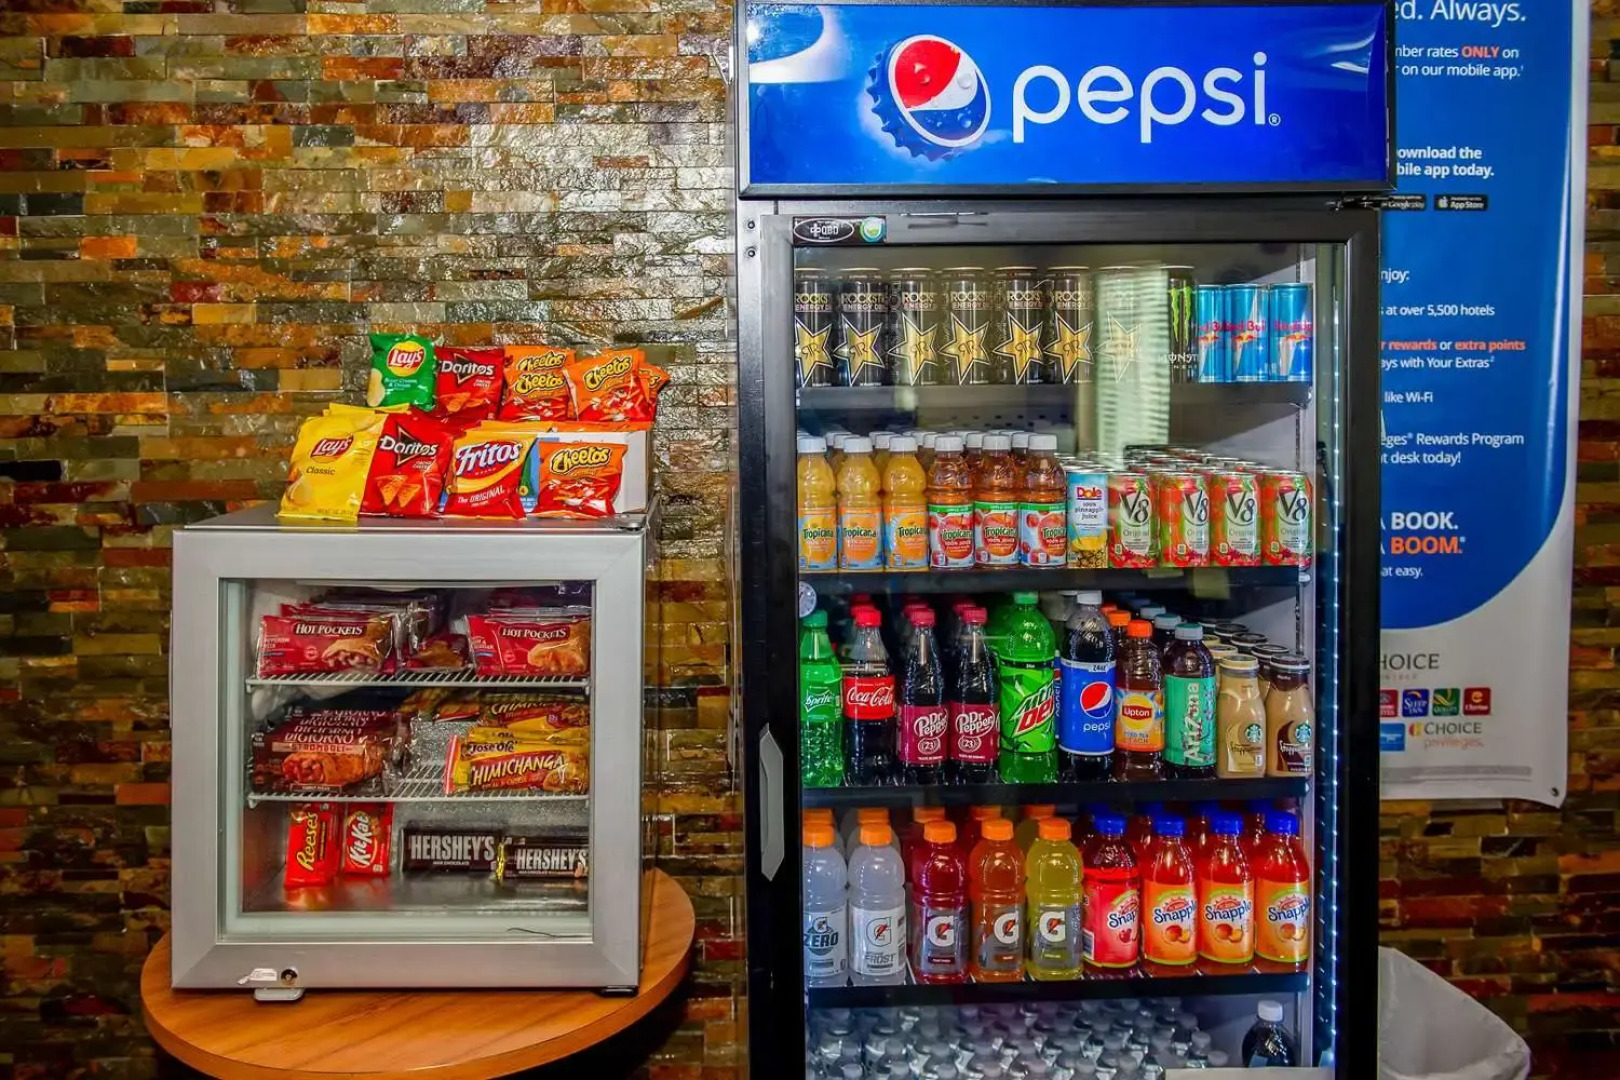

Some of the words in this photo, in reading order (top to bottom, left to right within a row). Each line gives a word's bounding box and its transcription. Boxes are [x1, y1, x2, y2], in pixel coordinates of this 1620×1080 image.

[1430, 0, 1527, 28] Always.
[1427, 46, 1459, 58] rates
[1461, 46, 1500, 58] ONLY
[1502, 48, 1519, 59] on
[1401, 65, 1419, 76] on
[1421, 65, 1445, 76] our
[1447, 63, 1491, 77] mobile
[1012, 51, 1269, 144] pepsi
[1459, 147, 1482, 159] the
[1424, 166, 1450, 179] app
[1453, 164, 1495, 179] today.
[1386, 305, 1398, 316] at
[1400, 306, 1424, 316] over
[1427, 304, 1458, 317] 5,500
[1461, 304, 1495, 316] hotels
[1389, 340, 1437, 351] rewards
[1440, 340, 1452, 350] or
[1454, 340, 1486, 351] extra
[1489, 340, 1526, 353] points
[441, 360, 494, 375] Doritos
[518, 352, 566, 371] Cheetos
[1400, 356, 1424, 368] with
[1427, 357, 1453, 368] Your
[585, 356, 631, 389] Cheetos
[515, 373, 566, 394] Cheetos
[1384, 392, 1404, 403] like
[1406, 392, 1433, 403] Wi-Fi
[379, 435, 438, 456] Doritos
[1416, 433, 1469, 446] Rewards
[1472, 434, 1524, 448] Program
[456, 442, 523, 476] Fritos
[551, 446, 610, 475] Cheetos
[1391, 451, 1420, 463] desk
[1423, 452, 1461, 467] today!
[306, 466, 336, 475] Classic
[470, 486, 505, 503] ORIGINAL
[1077, 487, 1102, 498] Dole
[1121, 491, 1149, 523] V8
[1184, 490, 1209, 522] V8
[1228, 491, 1256, 522] V8
[1280, 488, 1307, 522] V8
[1391, 511, 1459, 530] BOOK.
[1395, 567, 1424, 579] easy.
[296, 623, 318, 634] HOT
[318, 625, 363, 635] POCKETS
[502, 628, 522, 637] HOT
[523, 629, 567, 639] POCKETS
[805, 692, 831, 706] Sprite
[847, 687, 893, 706] Coca-Cola
[970, 712, 983, 727] Dr
[1124, 708, 1149, 716] Lipton
[1083, 721, 1111, 732] pepsi
[1424, 722, 1482, 735] CHOICE
[411, 836, 494, 860] HERSHEY'S
[516, 848, 587, 870] HERSHEY'S
[804, 932, 838, 947] ZERO
[866, 953, 894, 963] FROST
